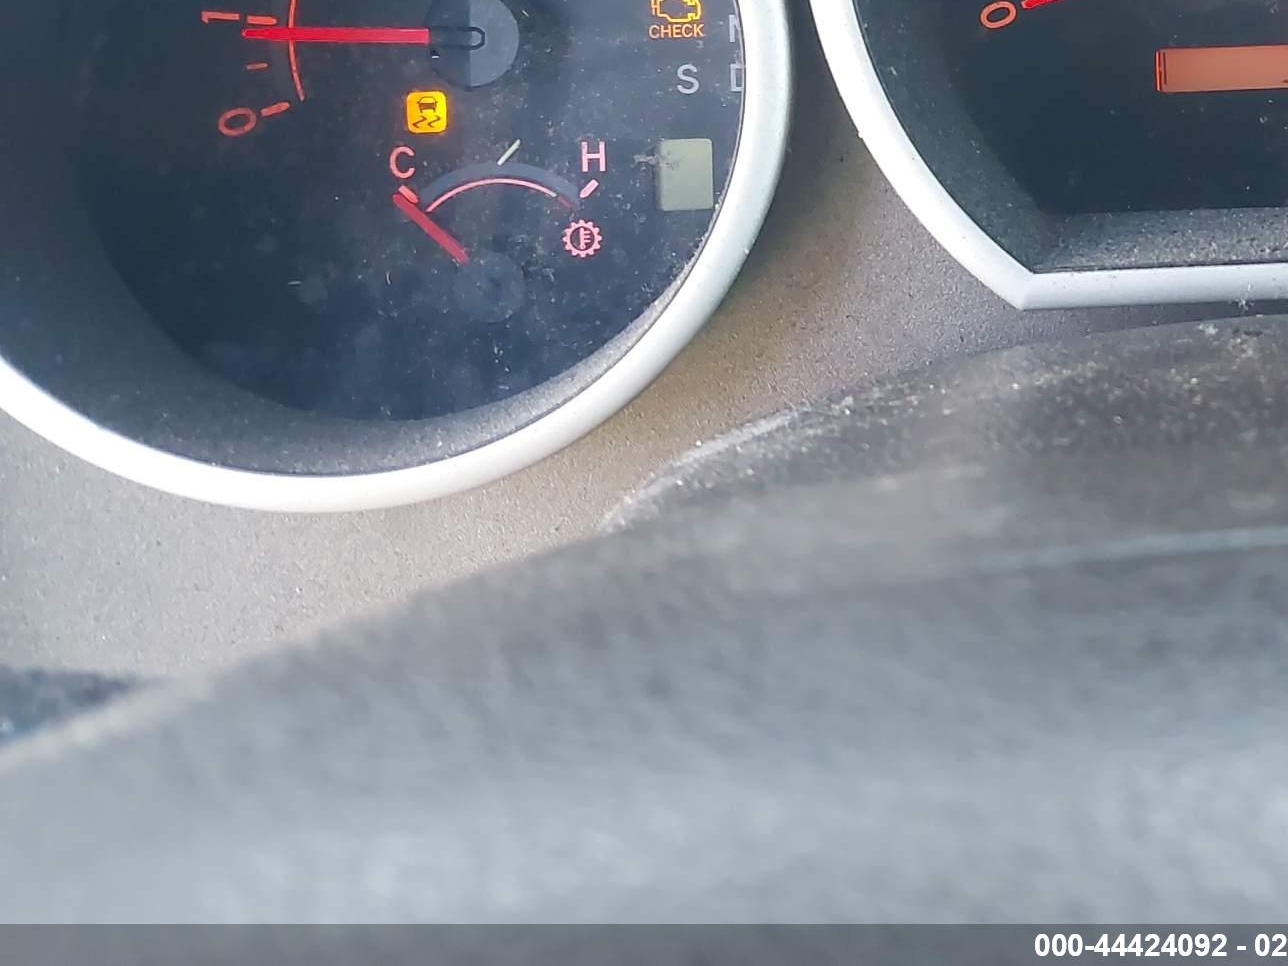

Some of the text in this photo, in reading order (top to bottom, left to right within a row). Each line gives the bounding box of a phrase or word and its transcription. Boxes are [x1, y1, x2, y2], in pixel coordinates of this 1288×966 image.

[201, 9, 239, 25] 1
[979, 0, 1018, 29] 0
[648, 24, 705, 39] CHECK
[676, 64, 700, 94] S
[218, 107, 258, 136] 0
[388, 146, 416, 178] C
[581, 142, 606, 172] H
